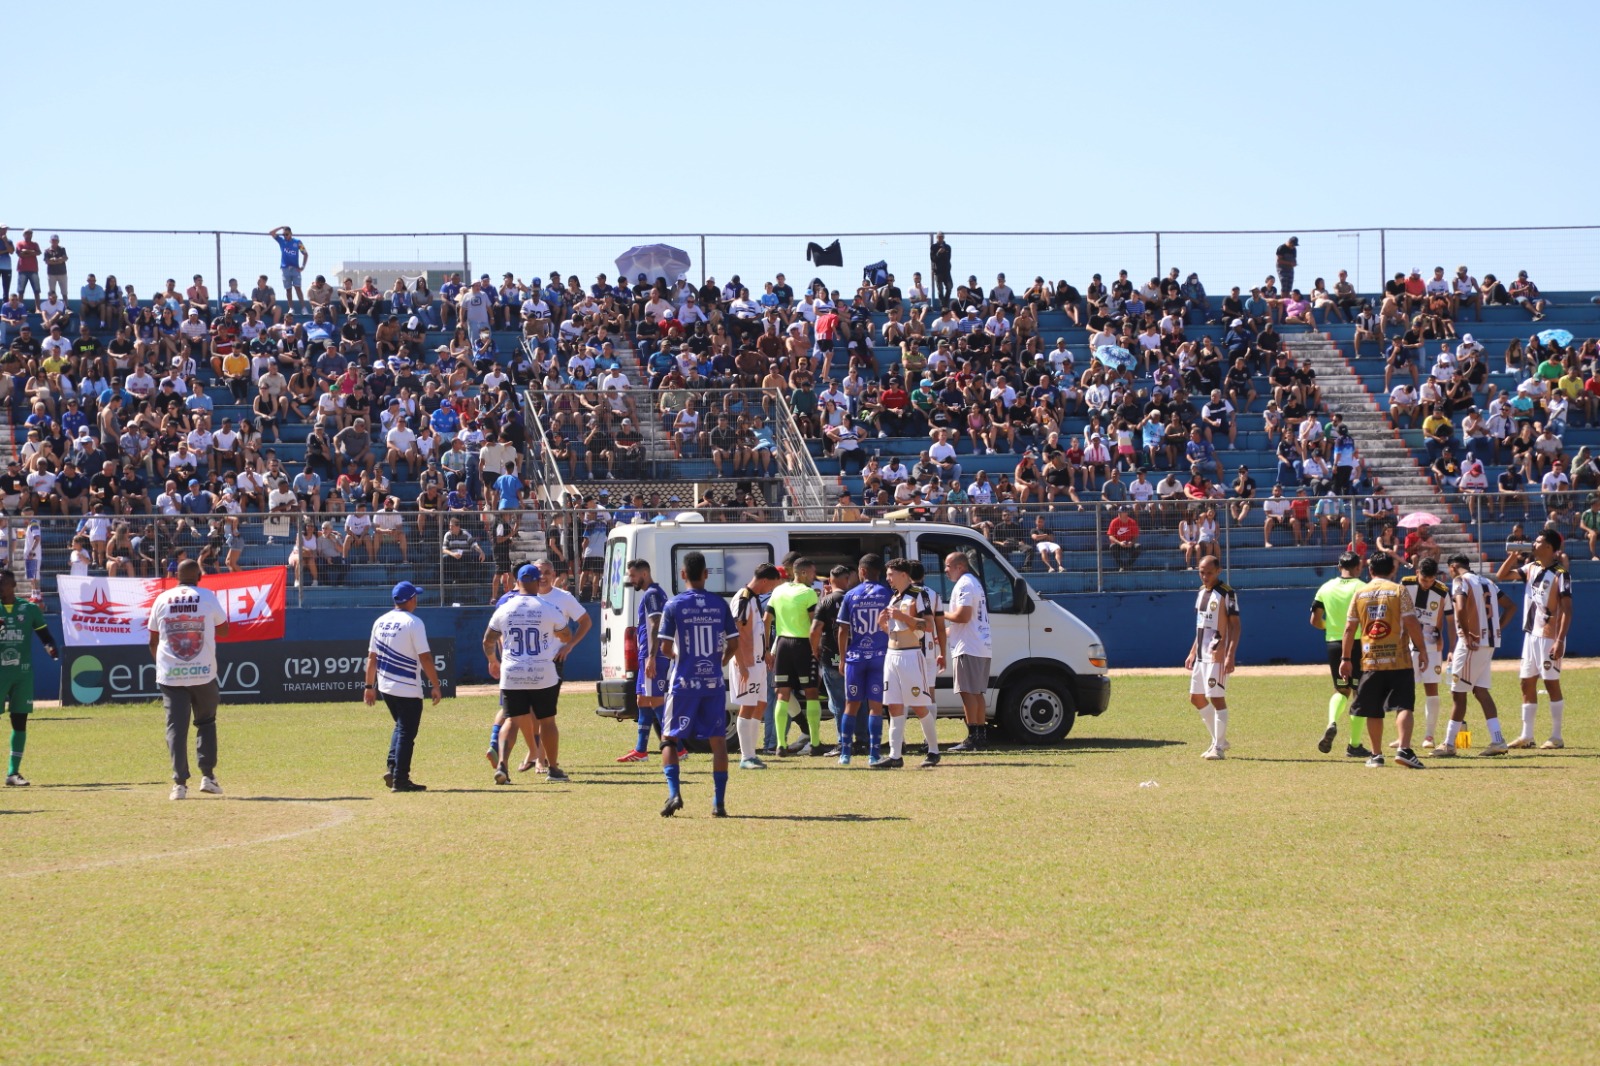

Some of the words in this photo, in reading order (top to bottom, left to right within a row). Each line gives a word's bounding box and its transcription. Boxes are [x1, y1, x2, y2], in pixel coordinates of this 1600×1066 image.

[170, 604, 198, 613] MUMU
[857, 608, 880, 636] 50
[509, 627, 541, 657] 30
[693, 625, 714, 658] 10
[284, 657, 320, 678] (12)
[283, 682, 345, 692] TRATAMENTO
[347, 681, 353, 690] E
[748, 682, 760, 694] 22
